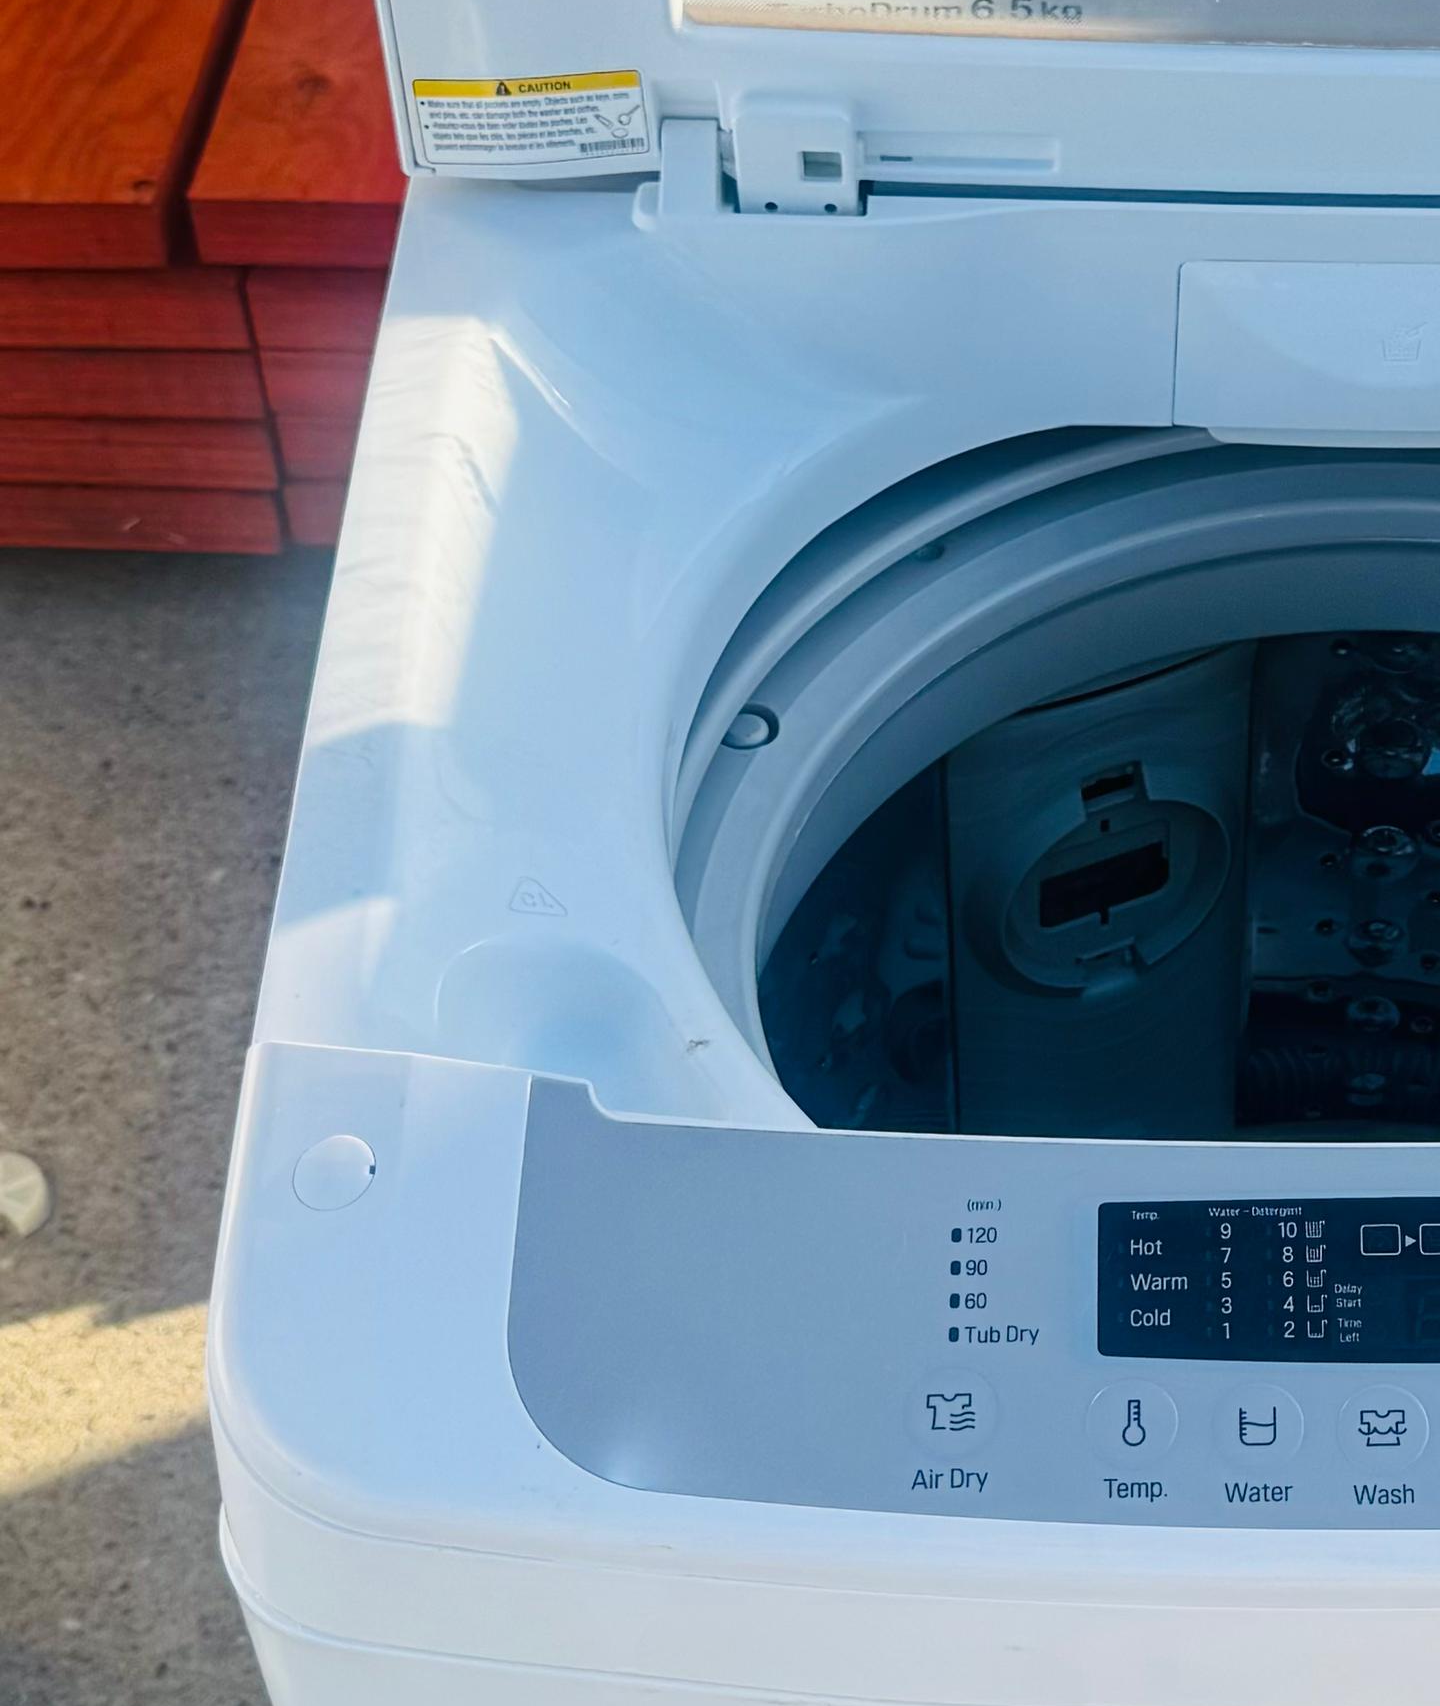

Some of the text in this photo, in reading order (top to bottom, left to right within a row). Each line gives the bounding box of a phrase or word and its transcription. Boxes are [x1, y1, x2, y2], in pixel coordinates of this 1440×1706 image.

[768, 1, 962, 19] TboDrum
[518, 82, 571, 93] CAUTION
[1209, 1207, 1240, 1217] Water
[968, 1226, 998, 1245] 120
[1220, 1223, 1231, 1239] 9
[1278, 1222, 1297, 1239] 10
[1130, 1239, 1162, 1255] Hot
[1221, 1247, 1231, 1263] 7
[1282, 1247, 1294, 1263] 8
[966, 1259, 988, 1277] 90
[1130, 1274, 1188, 1291] Warm
[1221, 1272, 1232, 1288] 5
[1283, 1272, 1294, 1288] 6
[1335, 1283, 1362, 1295] Delay
[964, 1292, 988, 1310] 60
[1221, 1297, 1232, 1314] 3
[1283, 1296, 1295, 1313] 4
[1336, 1297, 1361, 1308] Start
[1130, 1309, 1171, 1327] Cold
[1337, 1318, 1362, 1328] Time
[965, 1325, 1040, 1346] Tub Dry
[1223, 1322, 1230, 1339] 1
[1284, 1322, 1295, 1338] 2
[1339, 1332, 1360, 1343] Left
[911, 1469, 989, 1494] Air Dry
[1104, 1478, 1168, 1501] Temp.
[1225, 1482, 1293, 1504] Water
[1353, 1484, 1415, 1506] Wash
